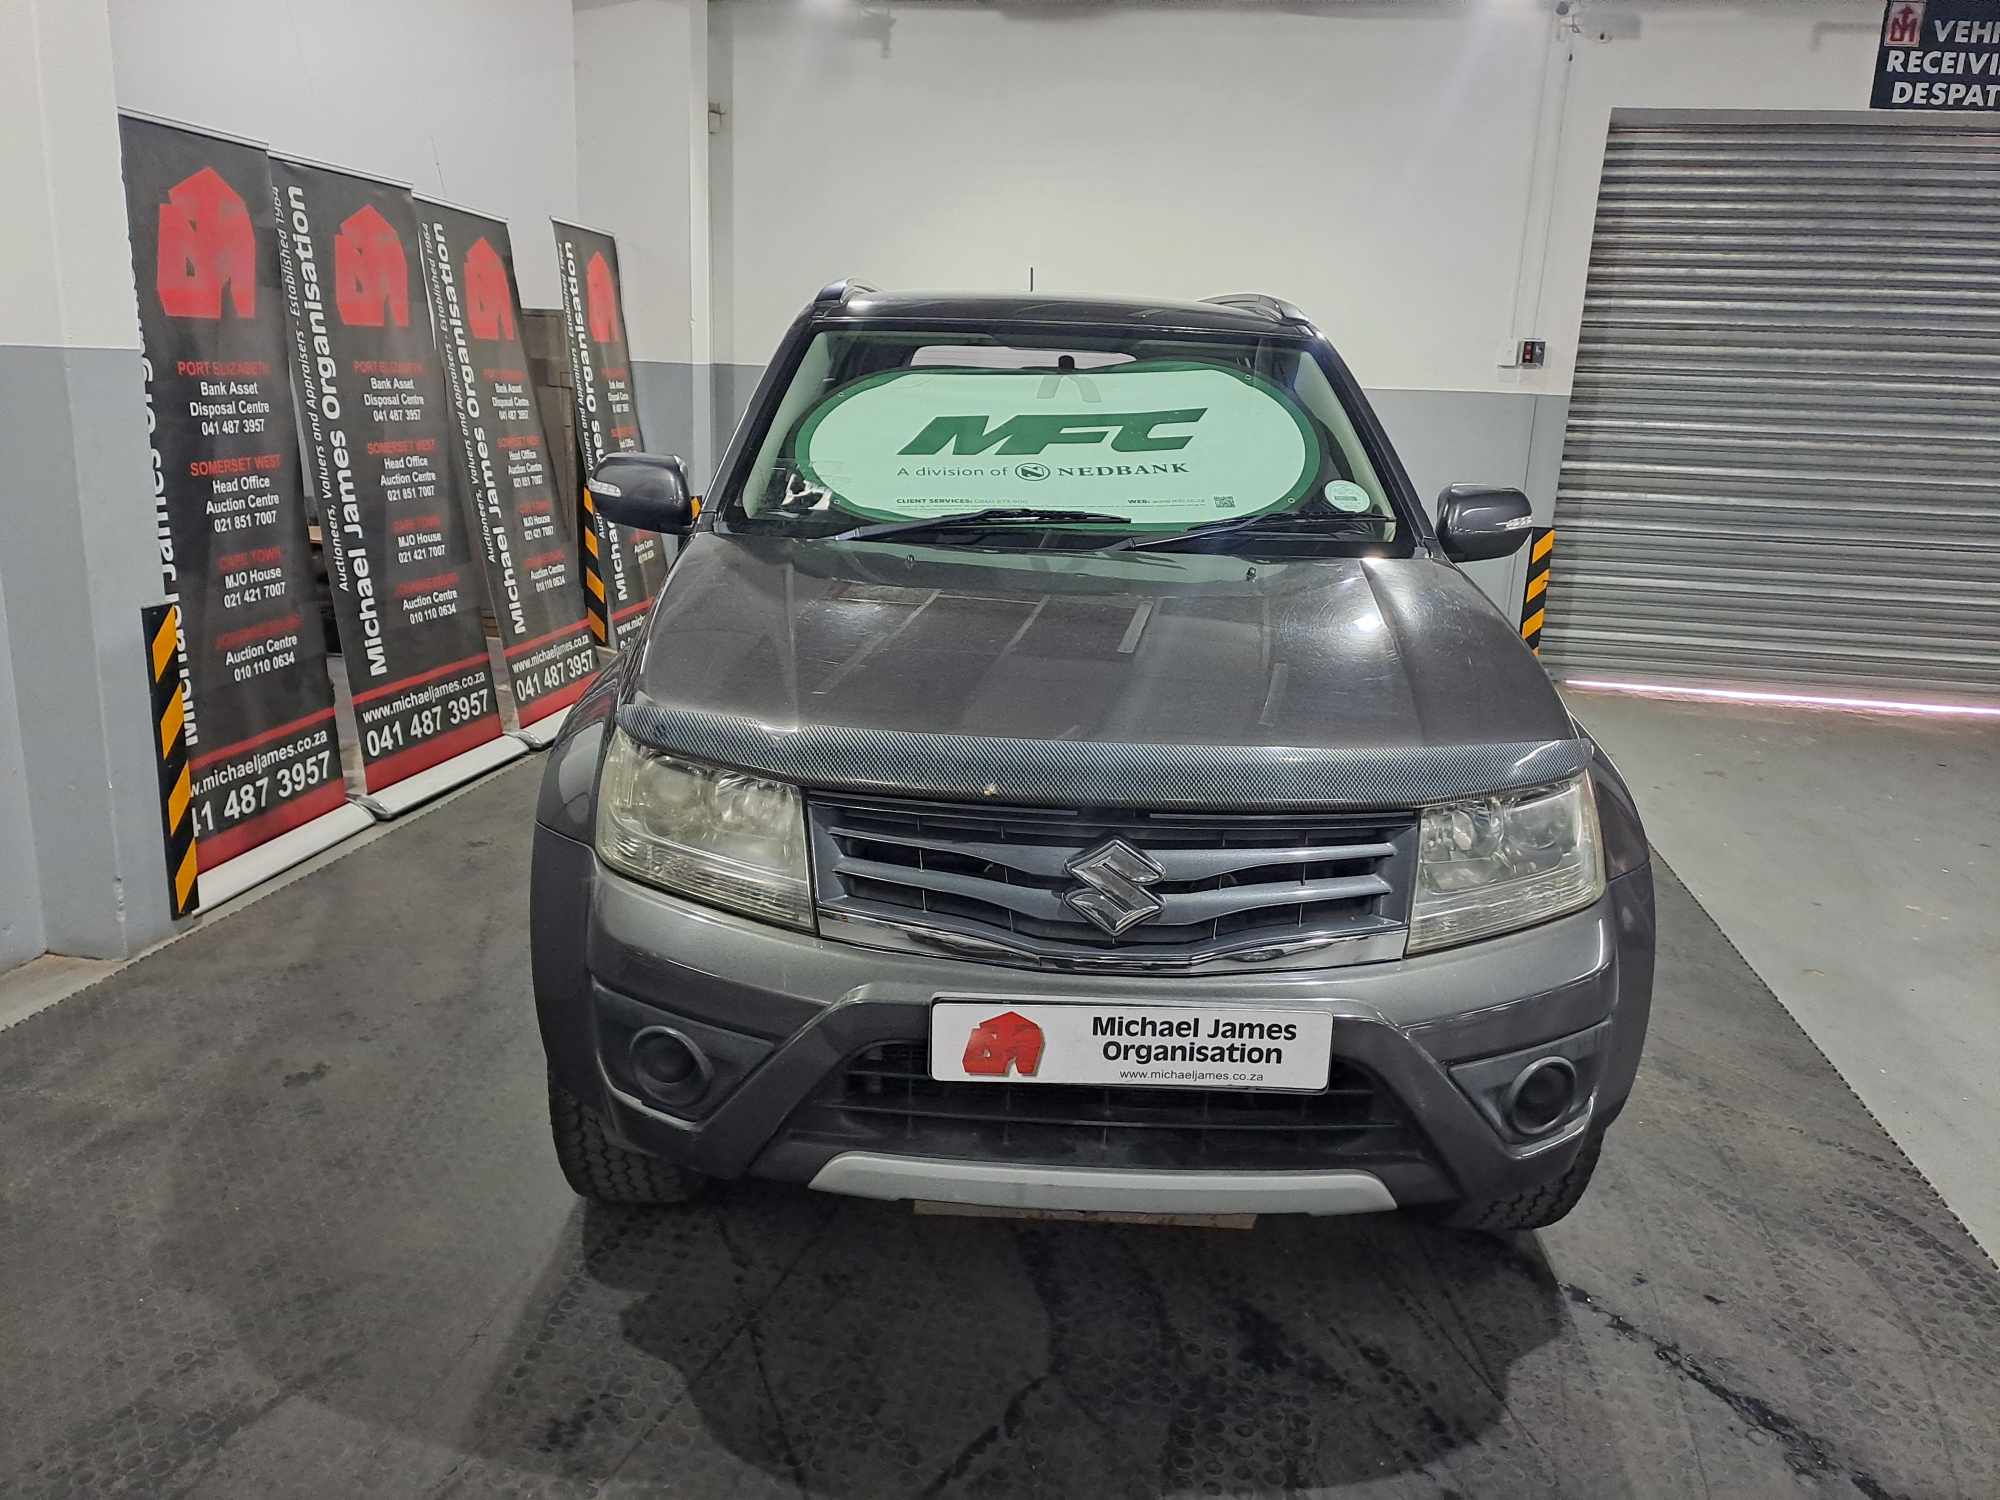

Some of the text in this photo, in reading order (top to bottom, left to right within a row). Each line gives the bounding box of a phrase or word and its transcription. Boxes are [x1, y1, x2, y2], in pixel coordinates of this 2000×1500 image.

[1886, 50, 2000, 76] RECEIVI
[1891, 81, 2000, 107] DESPAT
[276, 229, 300, 316] Established
[428, 257, 449, 331] Established
[565, 241, 597, 413] Organisation
[296, 330, 317, 409] Appraisers
[445, 342, 464, 410] Appraisers
[572, 347, 584, 406] Appraisers
[200, 381, 258, 396] Bank Asset
[370, 377, 415, 389] Bank Asset
[189, 400, 270, 418] Disposal Centre
[363, 393, 424, 407] Disposal Centre
[201, 418, 265, 436] 041 487 3957
[307, 411, 322, 442] and
[373, 410, 388, 422] 041
[433, 222, 527, 635] Michael James Organisation
[456, 411, 469, 437] and
[579, 407, 588, 429] and
[288, 186, 388, 678] Michael James Organisation
[896, 407, 1208, 456] MFC
[384, 455, 428, 470] Head Office
[464, 438, 478, 485] Valuers
[583, 431, 595, 471] Valuers
[190, 457, 250, 476] SOMERSET
[315, 445, 333, 499] Valuers
[380, 471, 437, 487] Auction Centre
[896, 462, 1191, 477] A division of NEDBANK
[212, 475, 270, 494] Head Office
[387, 489, 401, 501] 021
[418, 485, 435, 498] 7007
[206, 494, 280, 515] Auction Centre
[214, 511, 277, 533] 021 851 7007
[476, 488, 497, 564] Auctioneers,
[327, 503, 350, 592] Auctioneers,
[398, 532, 442, 548] MJO House
[398, 545, 445, 563] 021 421 7007
[224, 567, 282, 589] MJO House
[224, 582, 286, 609] 021 421 7007
[403, 589, 458, 611] Auction Centre
[410, 603, 457, 624] 010 110 0634
[225, 635, 298, 667] Auction Centre
[234, 652, 296, 682] 010 110 0634
[516, 649, 593, 701] 041 487 3957
[363, 671, 486, 724] www.michaeljames.co.za
[366, 688, 488, 757] 041 487 3957
[224, 777, 269, 820] 487
[277, 750, 330, 798] 3957
[1091, 1016, 1298, 1041] Michael James
[1102, 1041, 1282, 1065] Organisation
[1119, 1069, 1264, 1082] www.michaeljames.co.za
